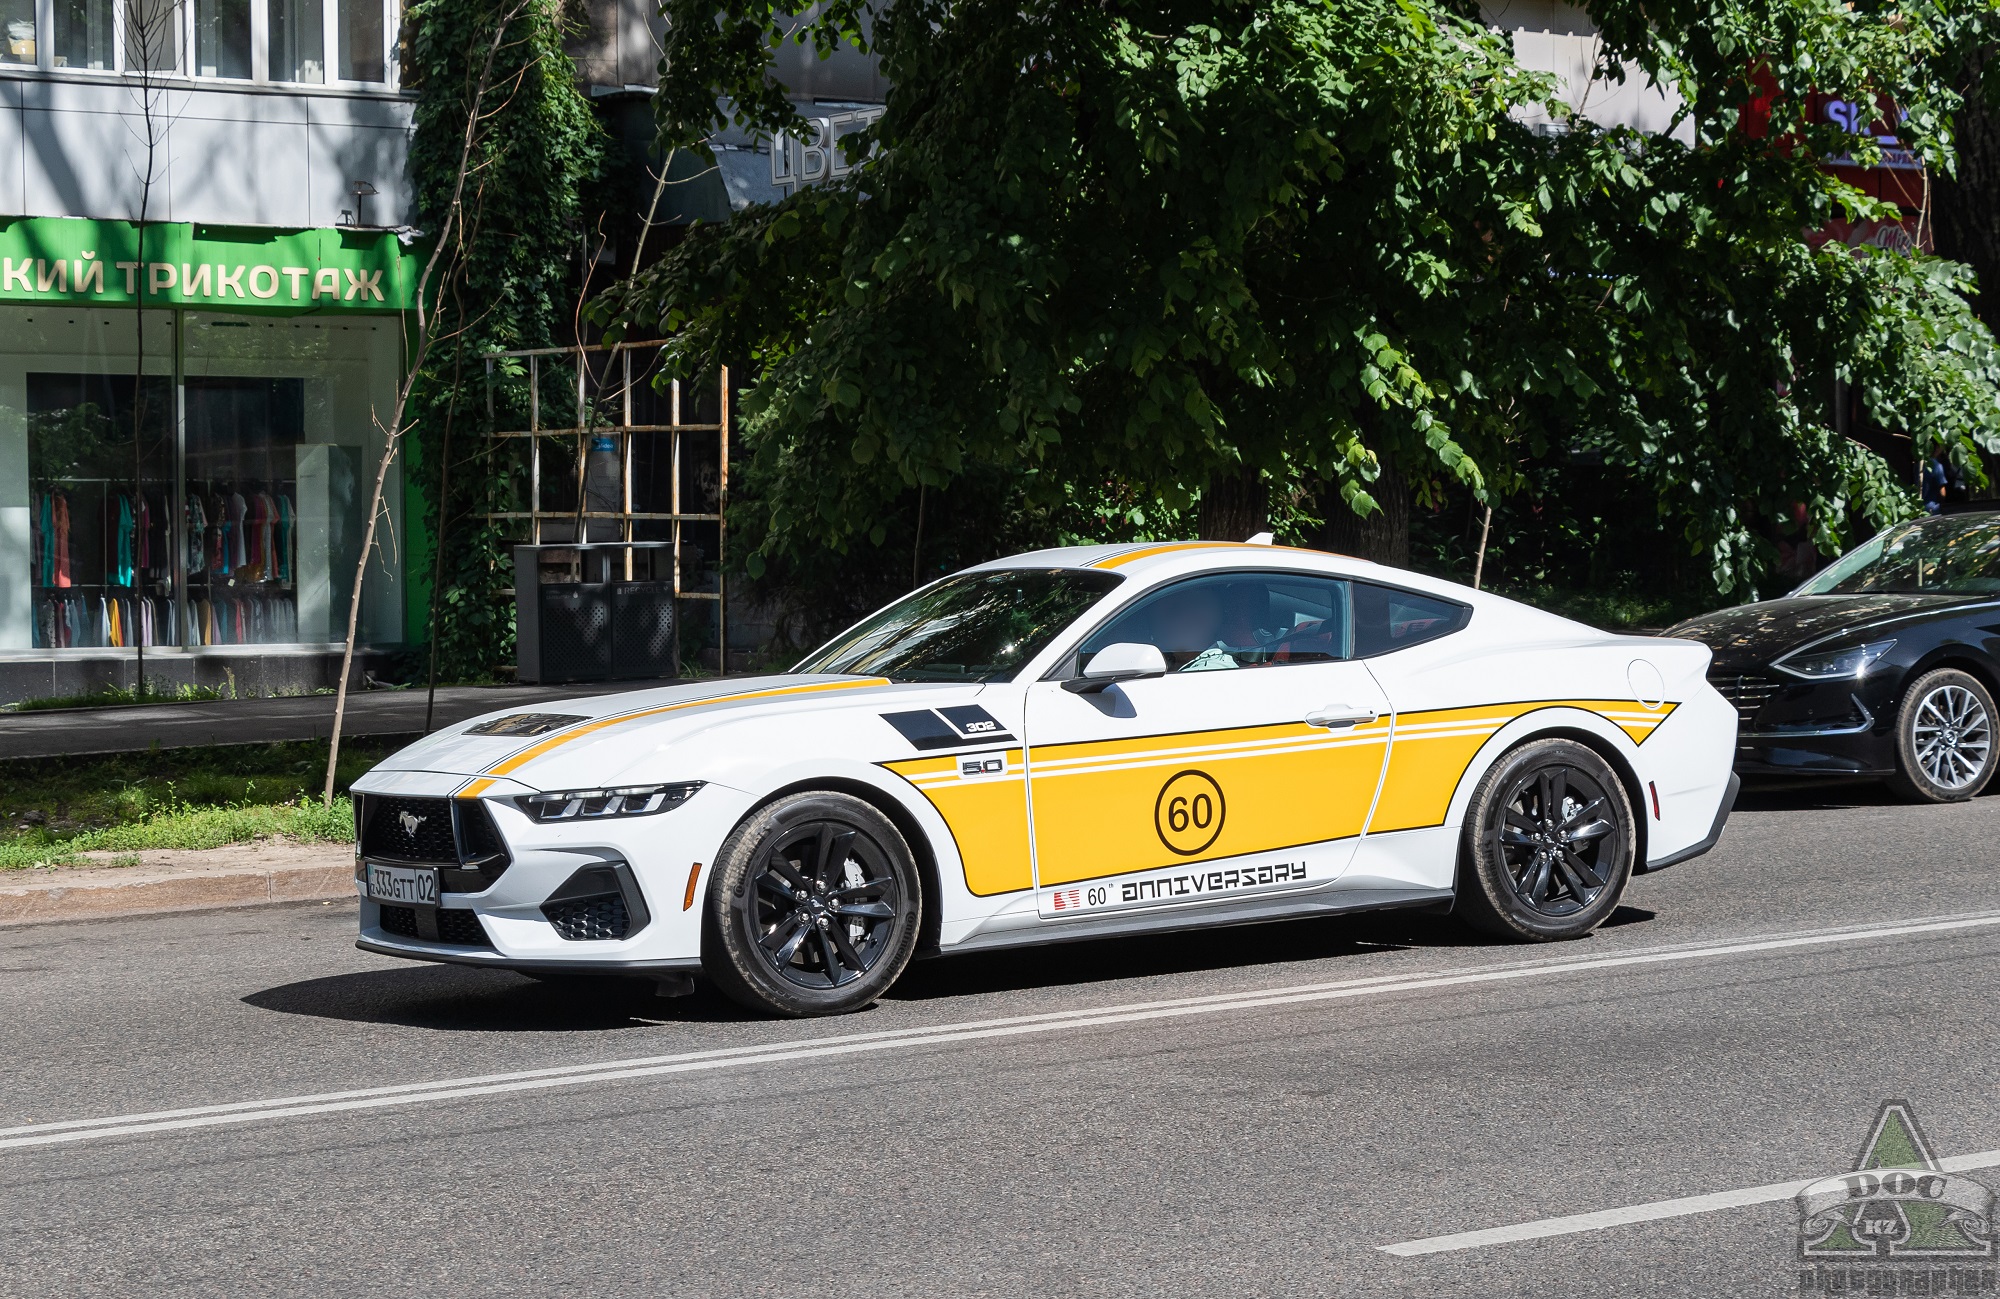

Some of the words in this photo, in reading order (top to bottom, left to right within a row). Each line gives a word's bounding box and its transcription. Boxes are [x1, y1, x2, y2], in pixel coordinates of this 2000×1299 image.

[3, 250, 104, 294] КИЙ
[116, 261, 386, 302] ТРИКОТАЖ
[624, 586, 661, 594] RECYCLE
[966, 720, 997, 733] 302
[962, 758, 1003, 775] 5.0
[1168, 793, 1213, 832] 60
[417, 873, 435, 902] 02
